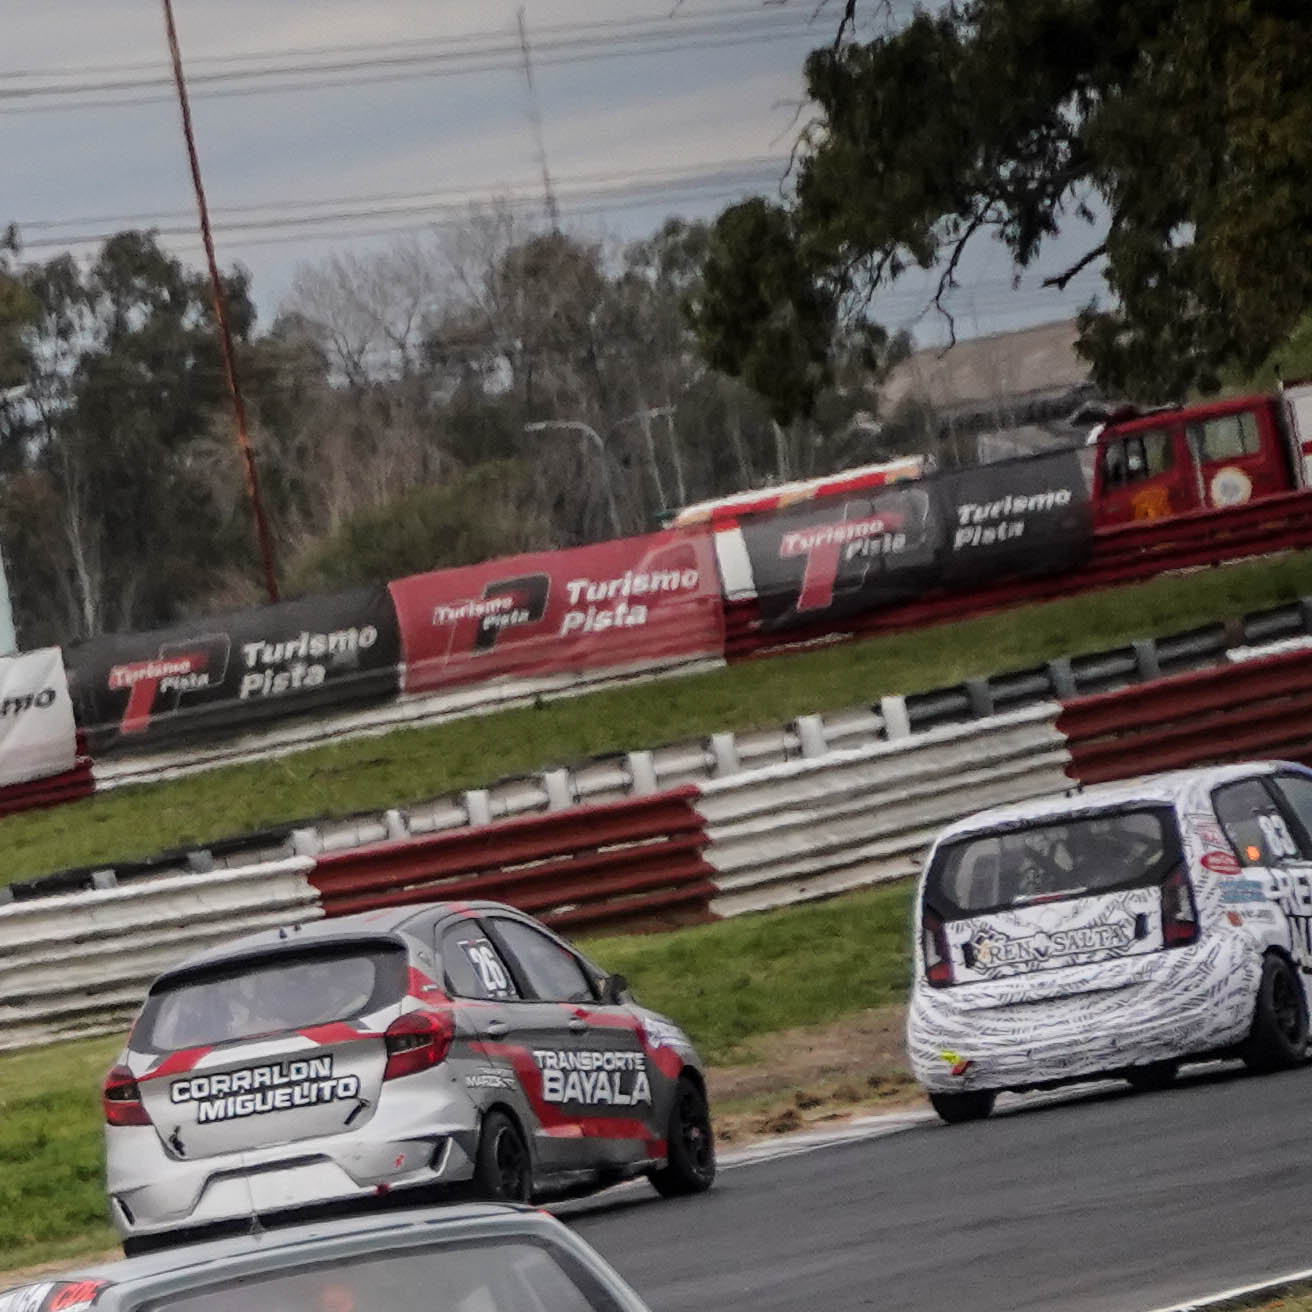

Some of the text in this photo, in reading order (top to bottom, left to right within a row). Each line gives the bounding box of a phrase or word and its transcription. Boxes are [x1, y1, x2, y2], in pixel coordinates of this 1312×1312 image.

[957, 489, 1072, 525] Turismo
[566, 569, 698, 605] Turismo
[559, 603, 649, 639] Pista
[243, 625, 377, 667] Turismo
[240, 664, 326, 699] Pista
[1053, 925, 1125, 952] SALTA
[469, 946, 508, 991] 26
[532, 1050, 646, 1071] TRANSPORTE
[171, 1055, 333, 1103] CORRALON
[543, 1069, 652, 1106] BAYALA
[198, 1075, 360, 1124] MIGUELITO
